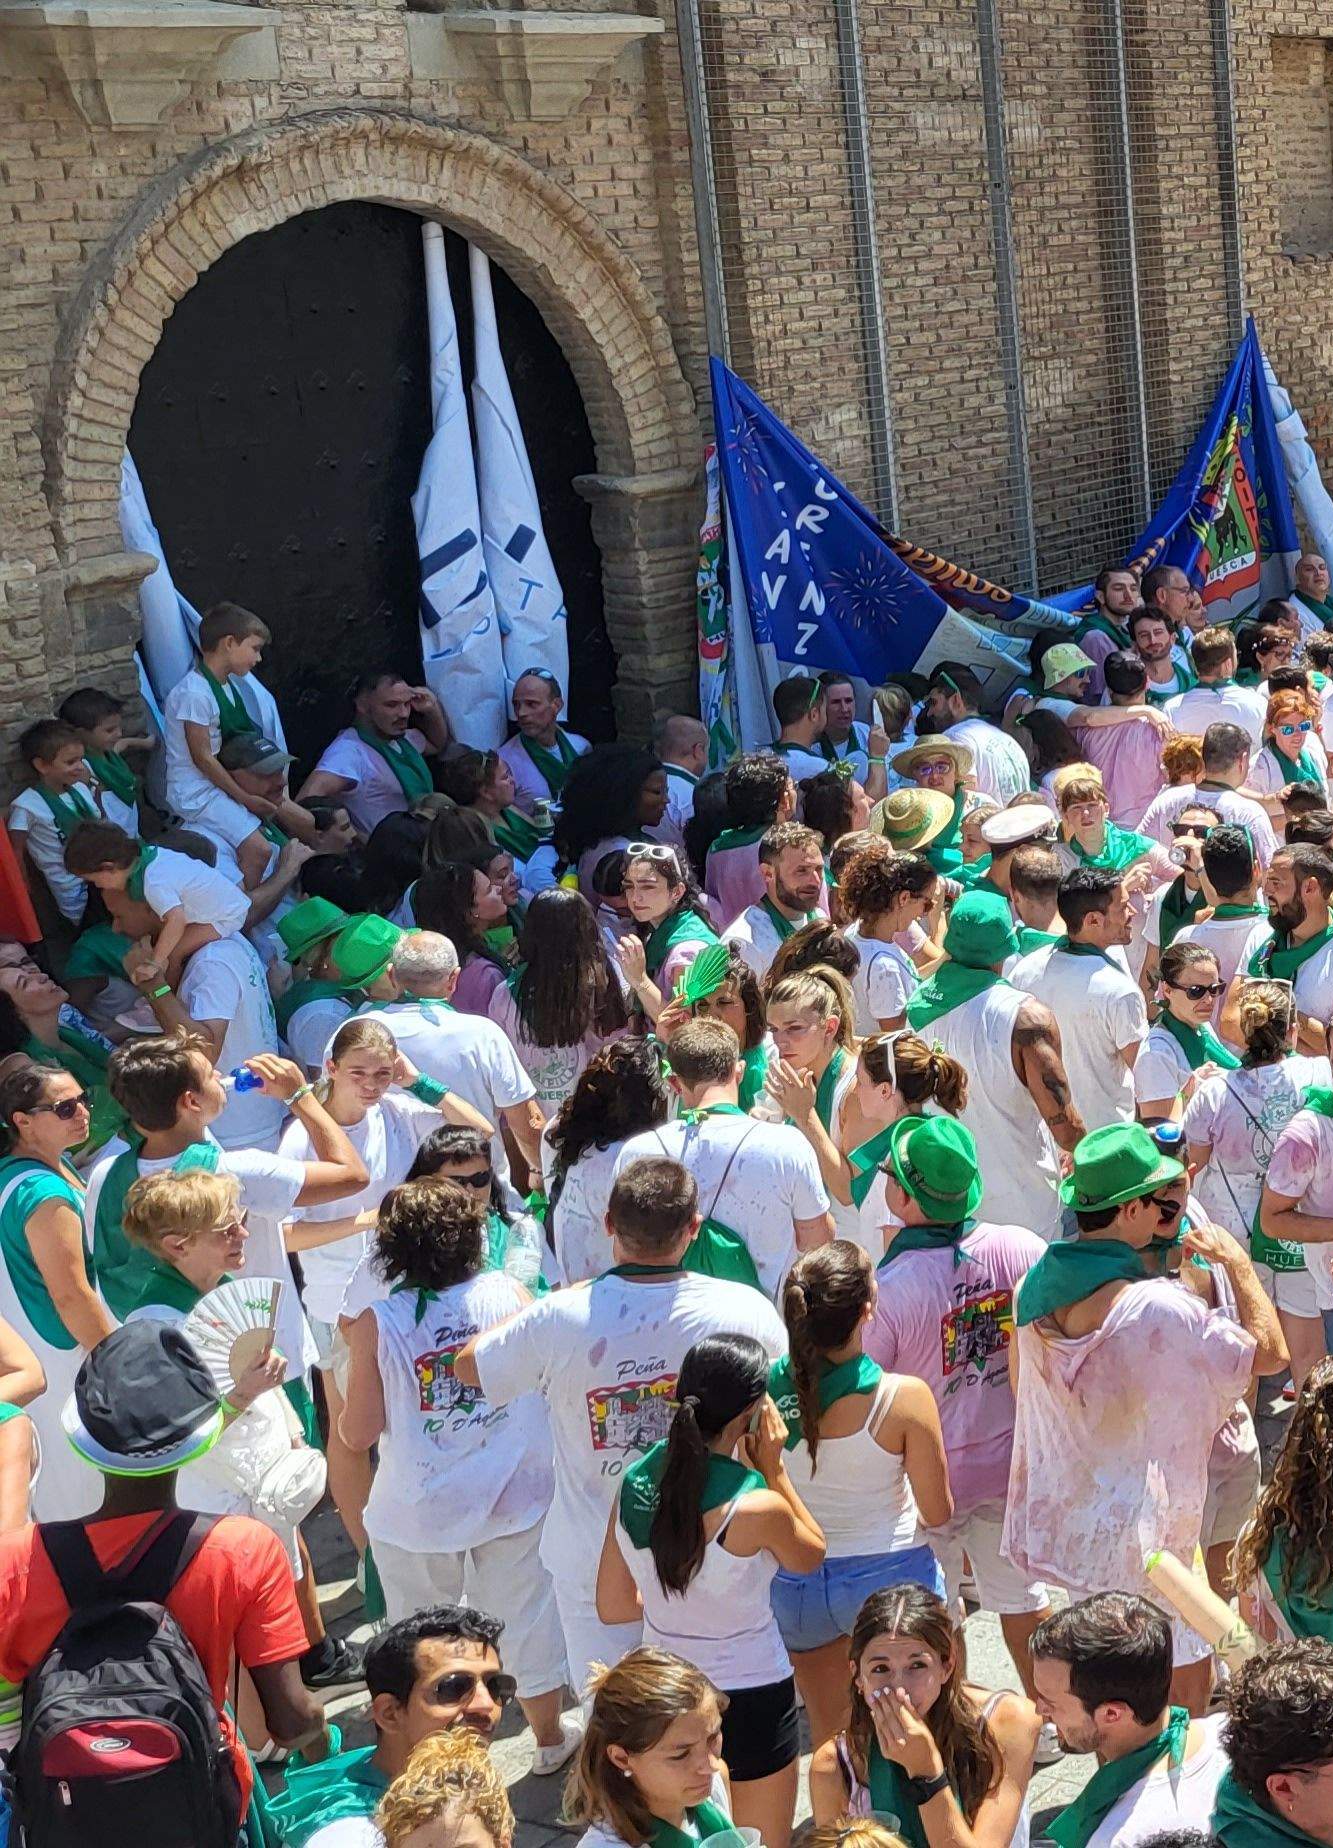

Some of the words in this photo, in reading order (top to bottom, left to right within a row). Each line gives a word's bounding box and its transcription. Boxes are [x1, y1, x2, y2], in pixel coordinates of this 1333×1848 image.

[1209, 559, 1248, 579] UESCA
[1265, 1254, 1302, 1266] HUE
[615, 1355, 668, 1380] Peña
[423, 1418, 446, 1435] 10
[600, 1460, 623, 1477] 10
